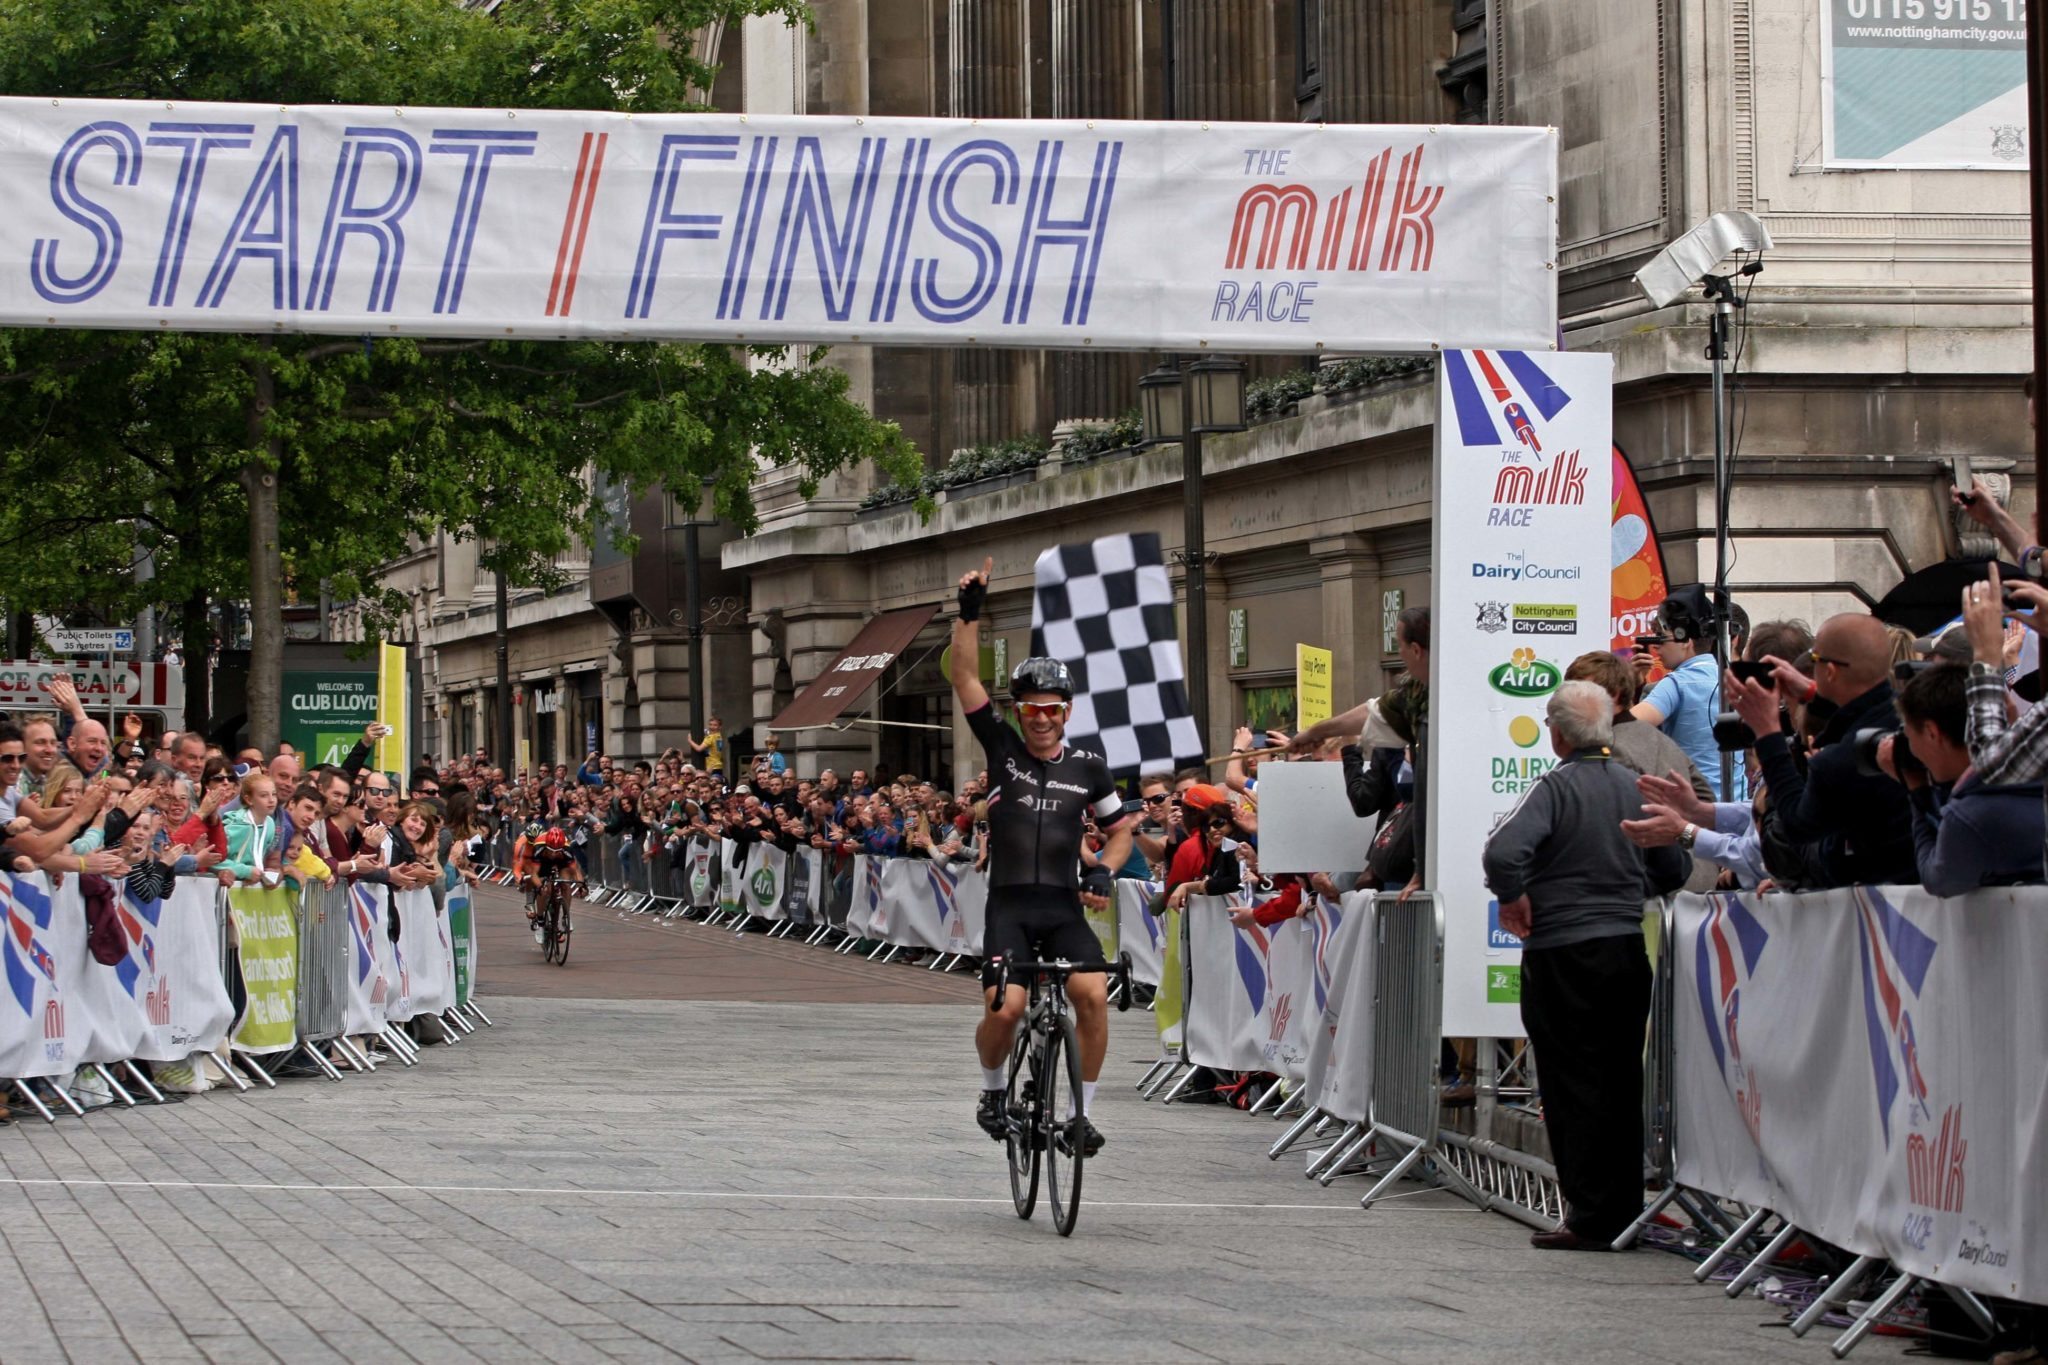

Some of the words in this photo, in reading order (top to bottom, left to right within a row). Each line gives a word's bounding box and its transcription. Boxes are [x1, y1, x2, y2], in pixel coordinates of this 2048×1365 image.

[1934, 0, 1991, 21] 915
[1244, 149, 1291, 175] THE
[1225, 143, 1444, 271] milk
[31, 121, 538, 315] START
[625, 134, 1122, 326] FINISH
[1211, 281, 1318, 323] RACE
[1501, 451, 1522, 463] THE
[1493, 449, 1588, 505] milk
[1487, 508, 1533, 527] RACE
[1507, 552, 1521, 561] The
[1472, 563, 1521, 580] Dairy
[1525, 564, 1580, 579] Council
[1383, 590, 1400, 610] ONE
[1230, 609, 1243, 628] ONE
[1384, 611, 1399, 632] DAY
[1515, 606, 1574, 618] Nottingham
[56, 632, 82, 640] Public
[1515, 621, 1536, 632] City
[1537, 621, 1575, 632] Council
[1230, 629, 1243, 647] DAY
[0, 672, 30, 692] CE
[37, 673, 126, 693] CEAM
[1500, 667, 1549, 687] Arla
[316, 683, 353, 691] WELCOME
[355, 683, 364, 691] TO
[292, 694, 331, 710] CLUB
[333, 694, 378, 711] LLOYD
[1005, 757, 1038, 786] Rapha
[1492, 757, 1556, 779] DAIRY
[1046, 780, 1088, 795] Condor
[1492, 781, 1523, 794] CRE
[1033, 798, 1062, 811] JLT
[1906, 1102, 1968, 1213] milk
[1958, 1239, 1981, 1265] Dairy
